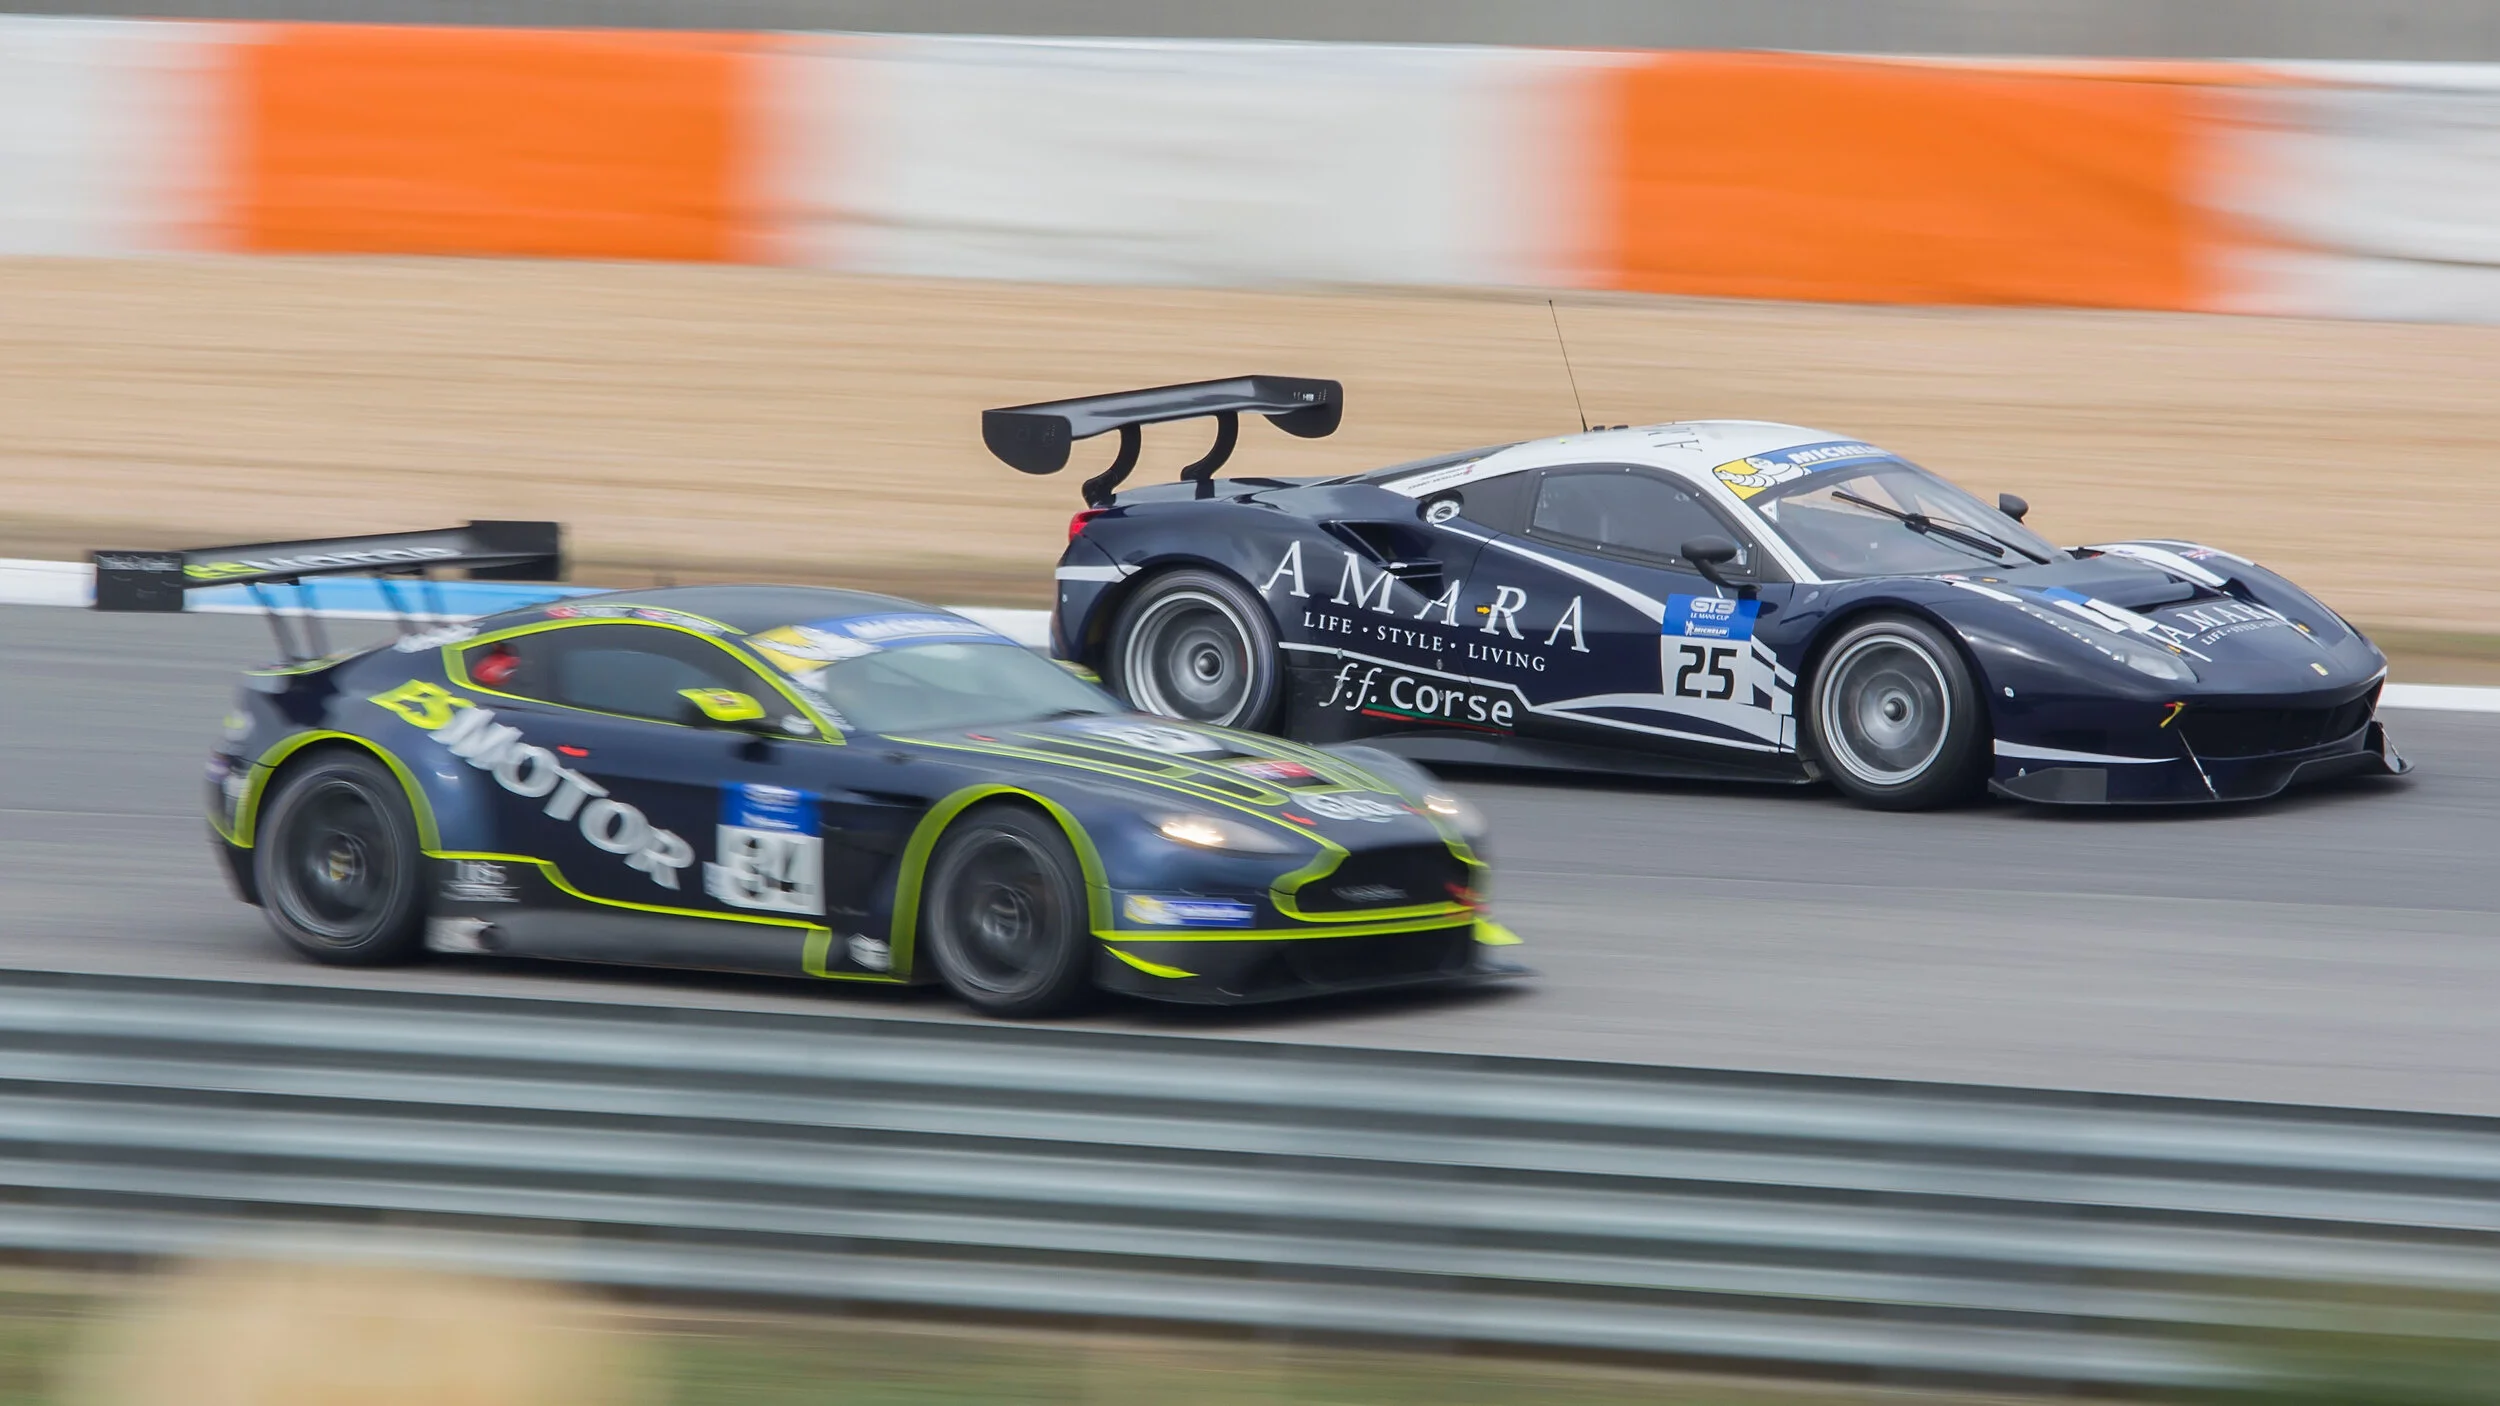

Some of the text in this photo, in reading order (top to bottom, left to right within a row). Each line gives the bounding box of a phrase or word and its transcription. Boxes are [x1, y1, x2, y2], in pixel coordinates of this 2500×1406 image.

[1787, 445, 1890, 464] MICHEL
[1259, 540, 1590, 653] AMARA
[1690, 597, 1737, 615] GT3
[1304, 612, 1547, 672] LIFE STYLE LIVING
[1694, 626, 1728, 635] MICHELIN
[2201, 629, 2228, 646] LIFE
[1675, 644, 1738, 700] 25
[1389, 676, 1514, 727] Corse
